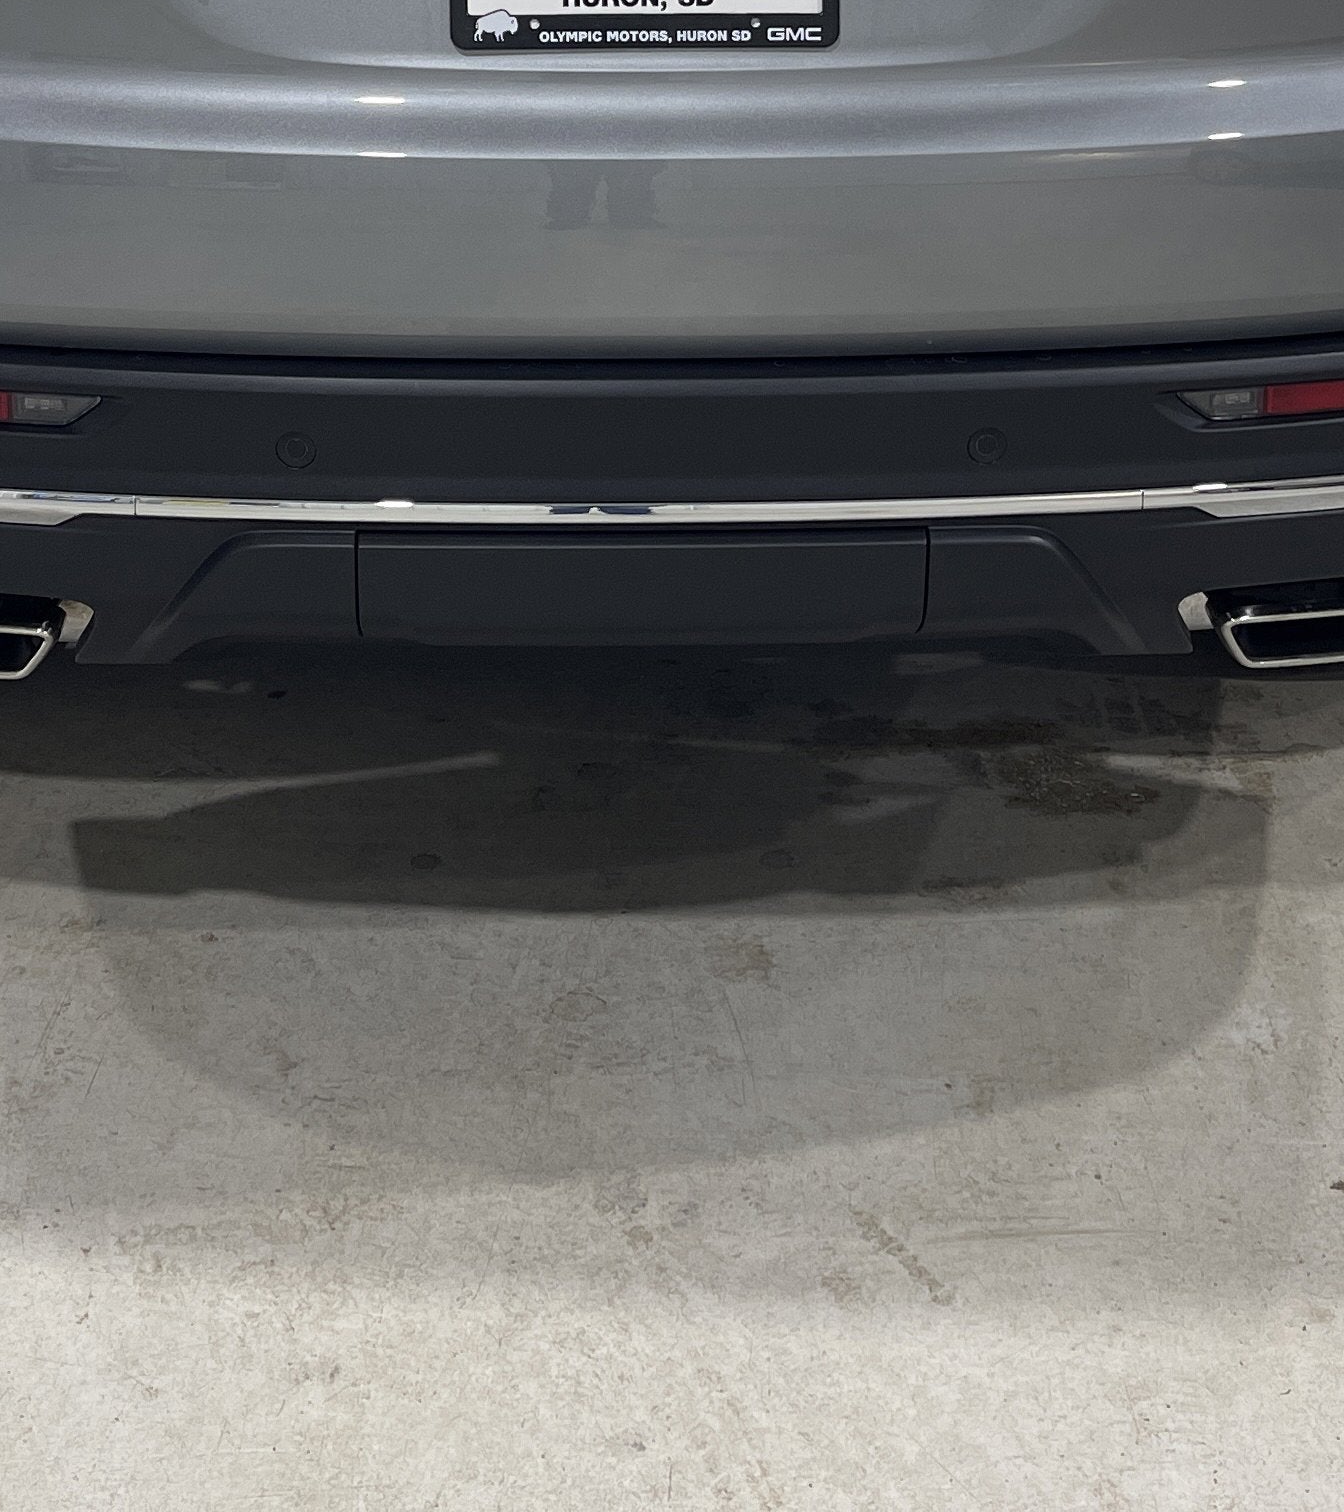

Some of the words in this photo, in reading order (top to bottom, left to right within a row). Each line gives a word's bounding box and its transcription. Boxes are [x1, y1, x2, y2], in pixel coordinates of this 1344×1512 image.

[539, 30, 603, 44] OLYMPIC
[606, 29, 673, 44] MOTORS,
[677, 29, 727, 43] HURON
[731, 29, 751, 43] SD
[766, 27, 822, 42] GMC
